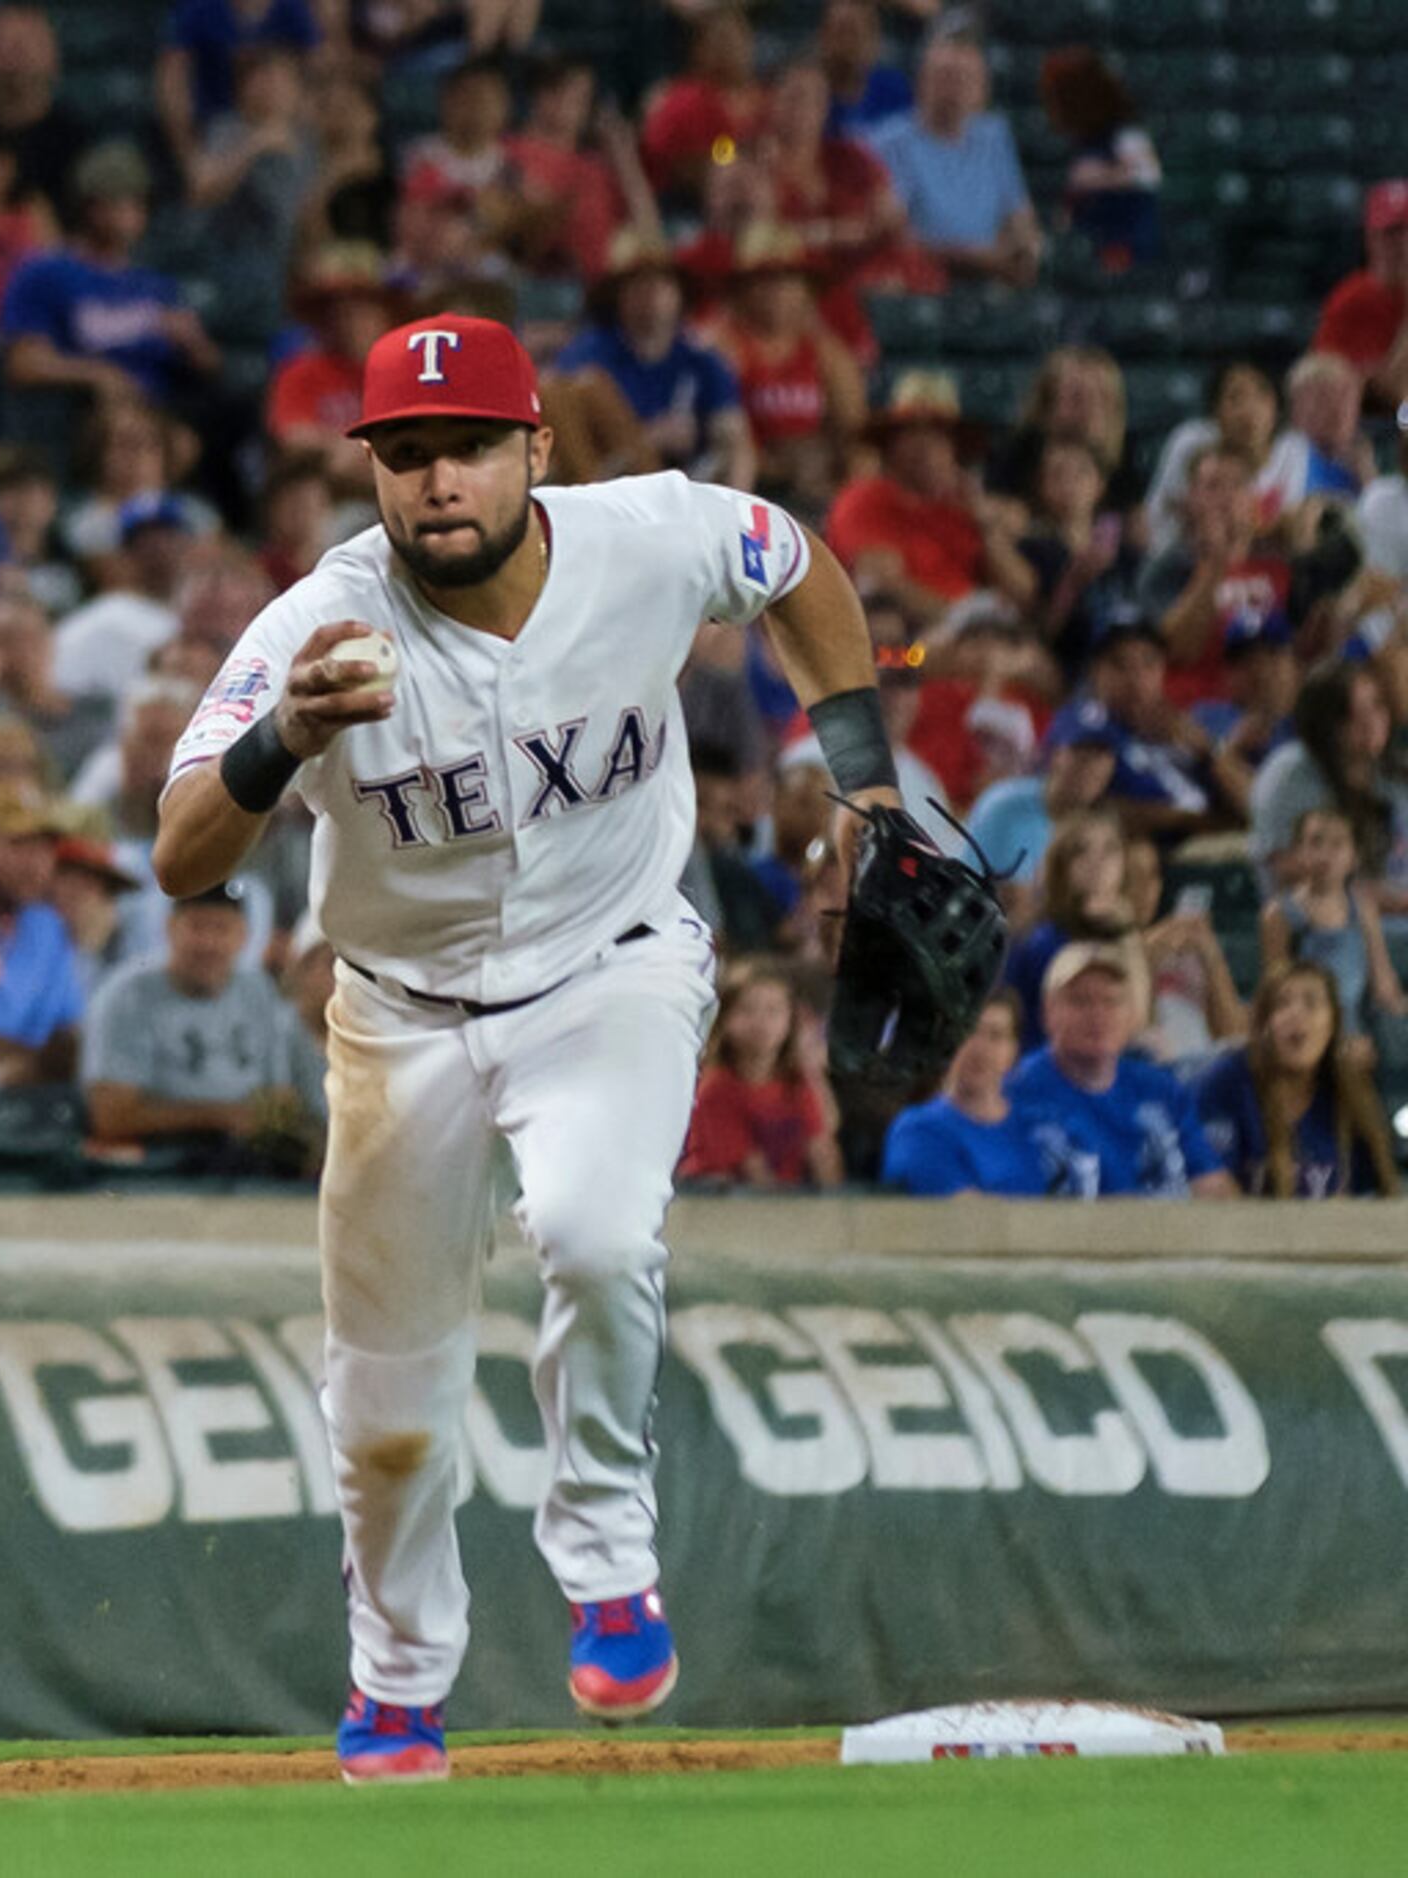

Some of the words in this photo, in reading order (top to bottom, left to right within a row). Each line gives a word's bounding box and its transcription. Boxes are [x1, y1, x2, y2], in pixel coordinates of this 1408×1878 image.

[407, 329, 462, 386] T
[352, 705, 668, 850] TEXA
[668, 1302, 1272, 1497] GEICO
